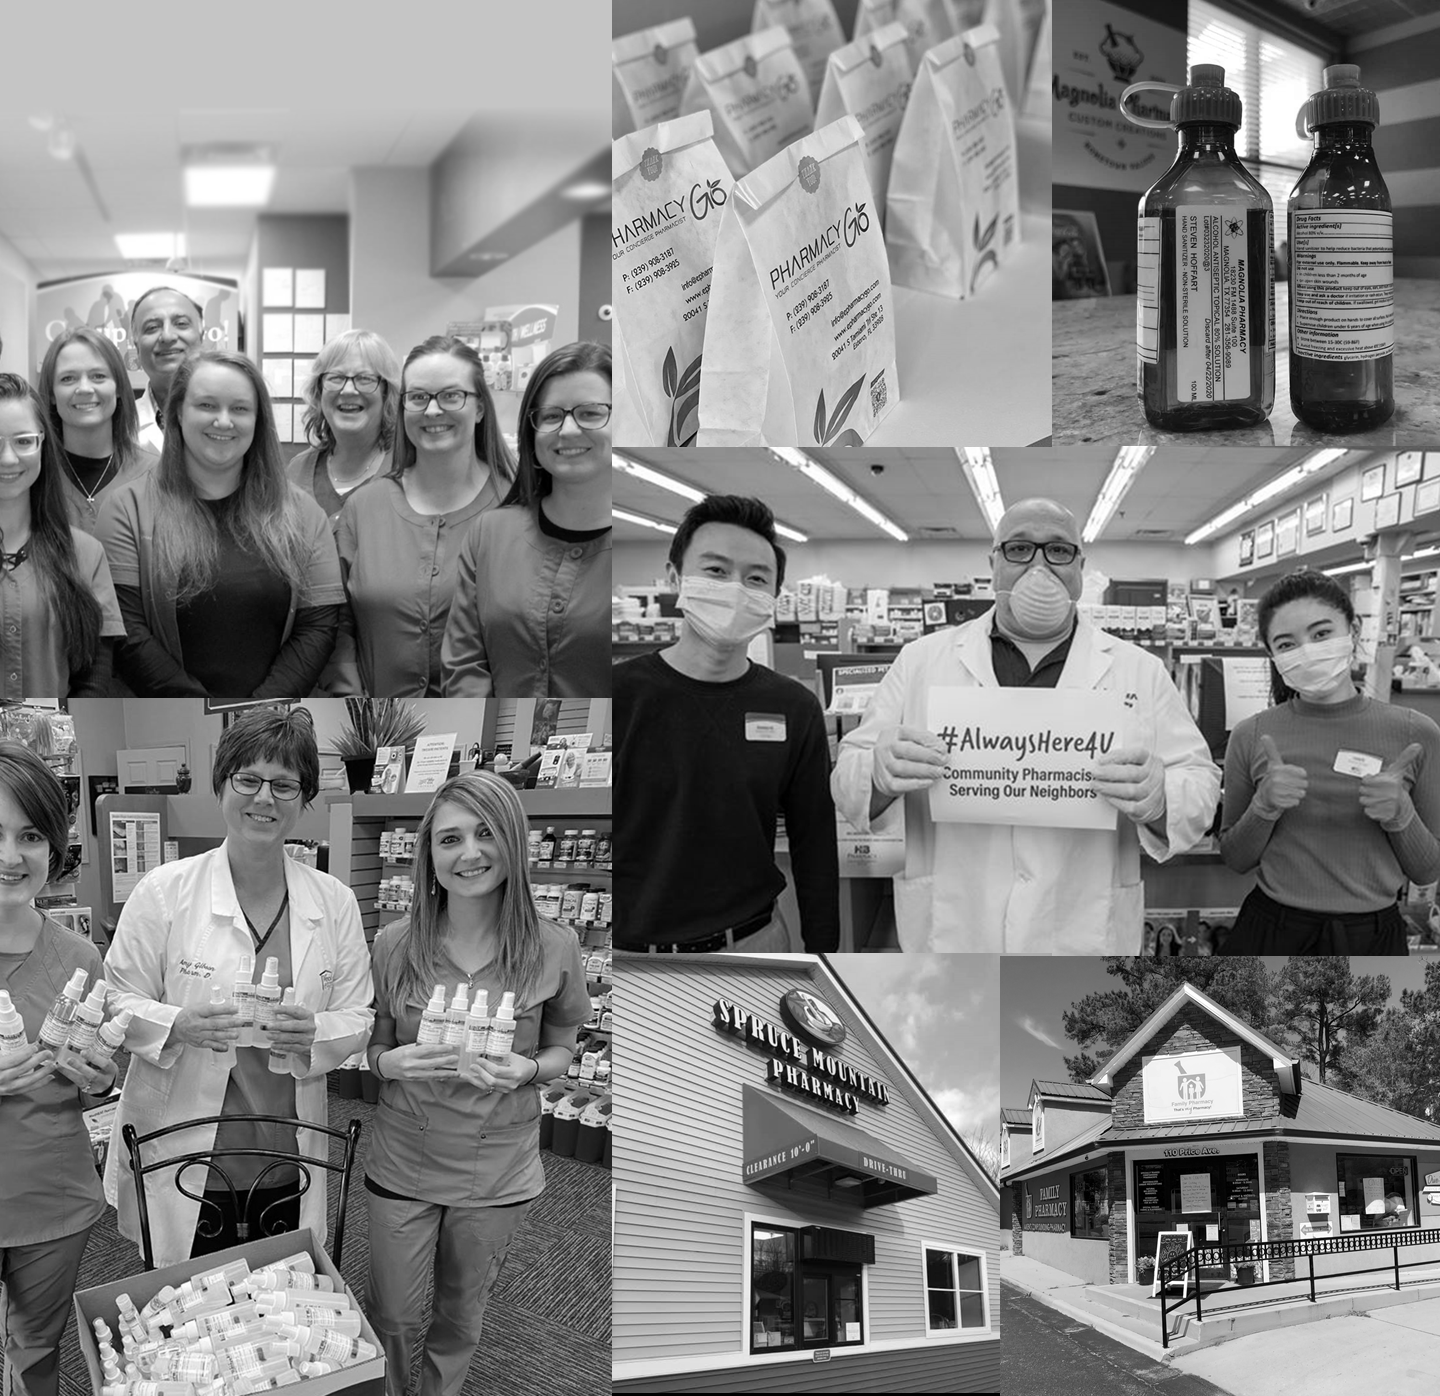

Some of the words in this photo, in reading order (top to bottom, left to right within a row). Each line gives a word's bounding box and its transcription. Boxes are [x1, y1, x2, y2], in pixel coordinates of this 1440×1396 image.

[1068, 112, 1112, 127] CUSTOM
[1115, 121, 1167, 140] CREATIONS
[626, 233, 654, 252] CONCIERGE
[655, 216, 686, 237] PHARMACIST
[1190, 215, 1198, 249] STEVEN
[1212, 215, 1220, 250] ALCOHOL
[622, 273, 630, 282] P:
[630, 262, 649, 278] (239)
[648, 247, 675, 267] 908-3187
[770, 219, 841, 290] PHARMACY
[626, 285, 634, 294] F:
[634, 274, 654, 290] (239)
[775, 285, 790, 299] YOUR
[790, 264, 817, 288] CONCIERGE
[816, 243, 841, 267] PHARMACIST
[1190, 252, 1198, 292] HOFFART
[1212, 251, 1220, 294] ANTISEPTIC
[1238, 259, 1246, 303] MAGNOLIA
[1224, 287, 1231, 296] TX
[1231, 286, 1237, 297] FM
[786, 312, 793, 321] P:
[1213, 295, 1221, 326] TOPICAL
[789, 325, 796, 334] F:
[1213, 327, 1221, 343] 80%
[1239, 305, 1247, 354] PHARMACY
[1313, 352, 1343, 360] ingredients
[937, 726, 1115, 761] #AlwaysHere4U
[943, 765, 1019, 784] Community
[1022, 767, 1097, 783] Pharmacis
[949, 783, 1000, 799] Serving
[1003, 784, 1027, 799] Our
[1030, 784, 1098, 801] Neighbors
[718, 998, 802, 1060] SPRUCE
[772, 1057, 861, 1113] PHARMACY
[811, 1046, 891, 1104] MOUNTAIN
[746, 1151, 787, 1176] CLEARANCE
[1163, 1149, 1178, 1158] 110
[1179, 1147, 1200, 1156] Price
[1201, 1146, 1220, 1155] Ave.
[863, 1156, 907, 1181] DRIVE-THRU
[1040, 1184, 1060, 1201] FAMILY
[1035, 1201, 1068, 1218] PHARMACY
